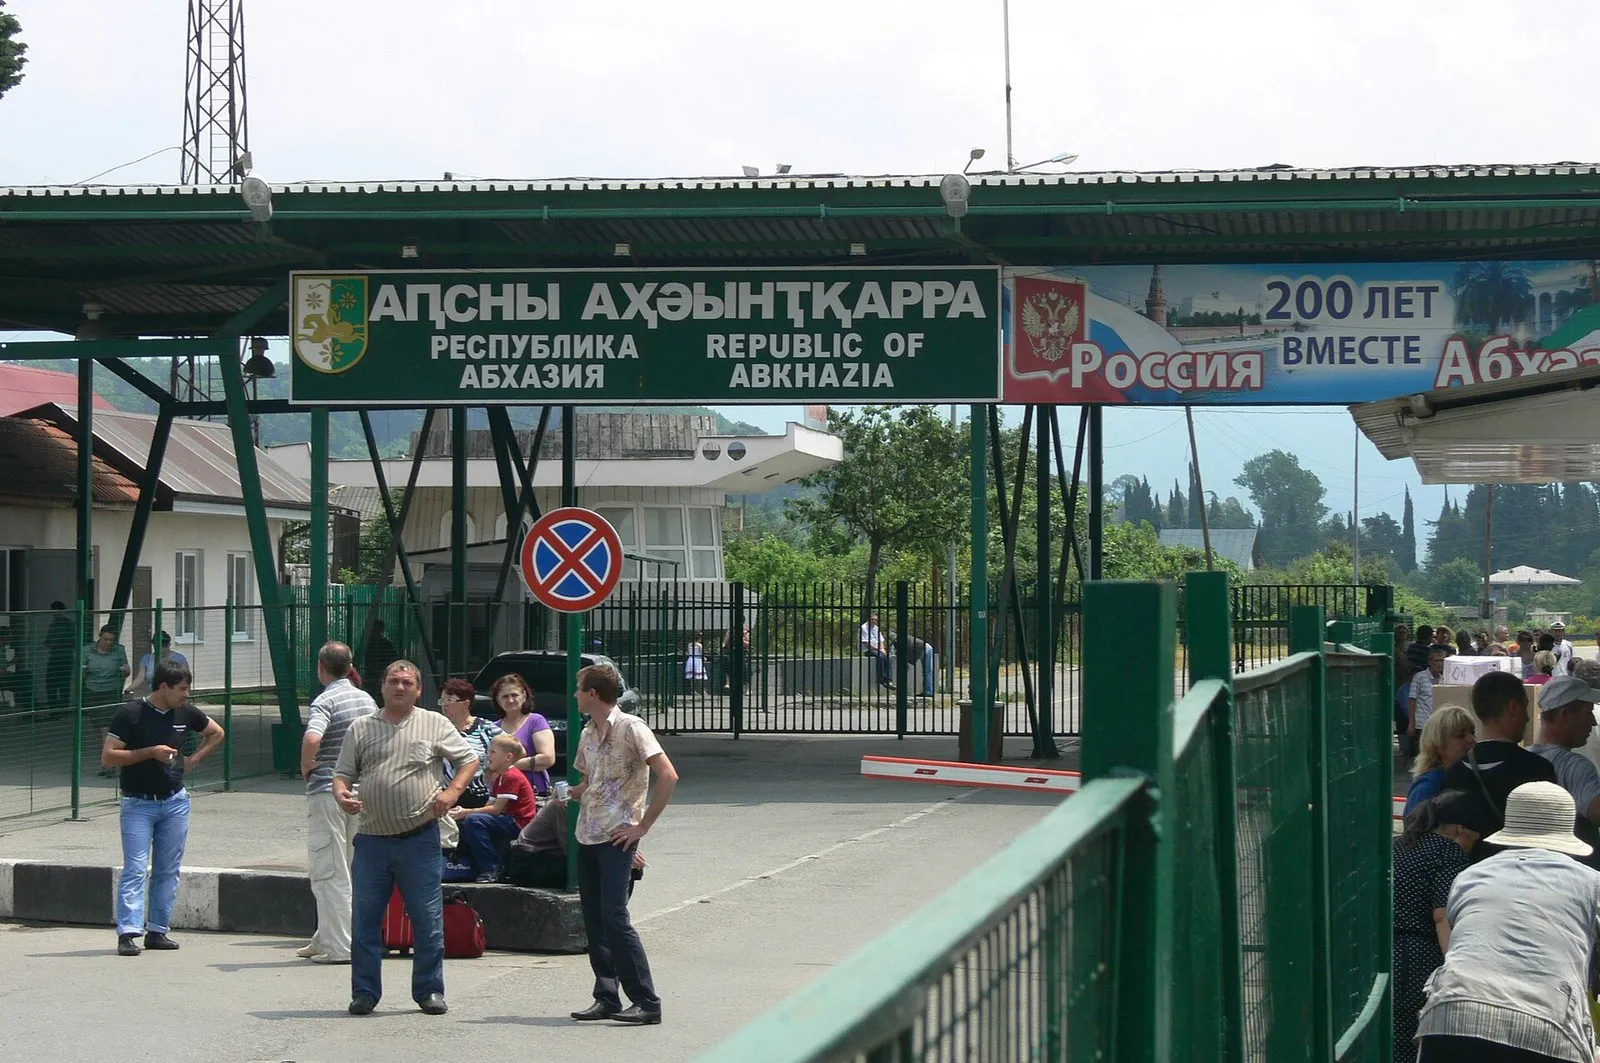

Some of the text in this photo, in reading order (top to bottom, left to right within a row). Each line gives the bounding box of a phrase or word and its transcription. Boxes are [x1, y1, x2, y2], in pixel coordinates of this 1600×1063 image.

[1264, 279, 1440, 320] 200 ЛЕТ
[430, 334, 640, 360] РЕСПУБЛИКА
[706, 332, 925, 359] REPUBLIC OF
[1282, 335, 1421, 366] ВМЕСТЕ
[459, 364, 605, 389] АБХАЗИЯ
[729, 362, 895, 389] ABKHAZIA
[1070, 342, 1264, 390] Россия
